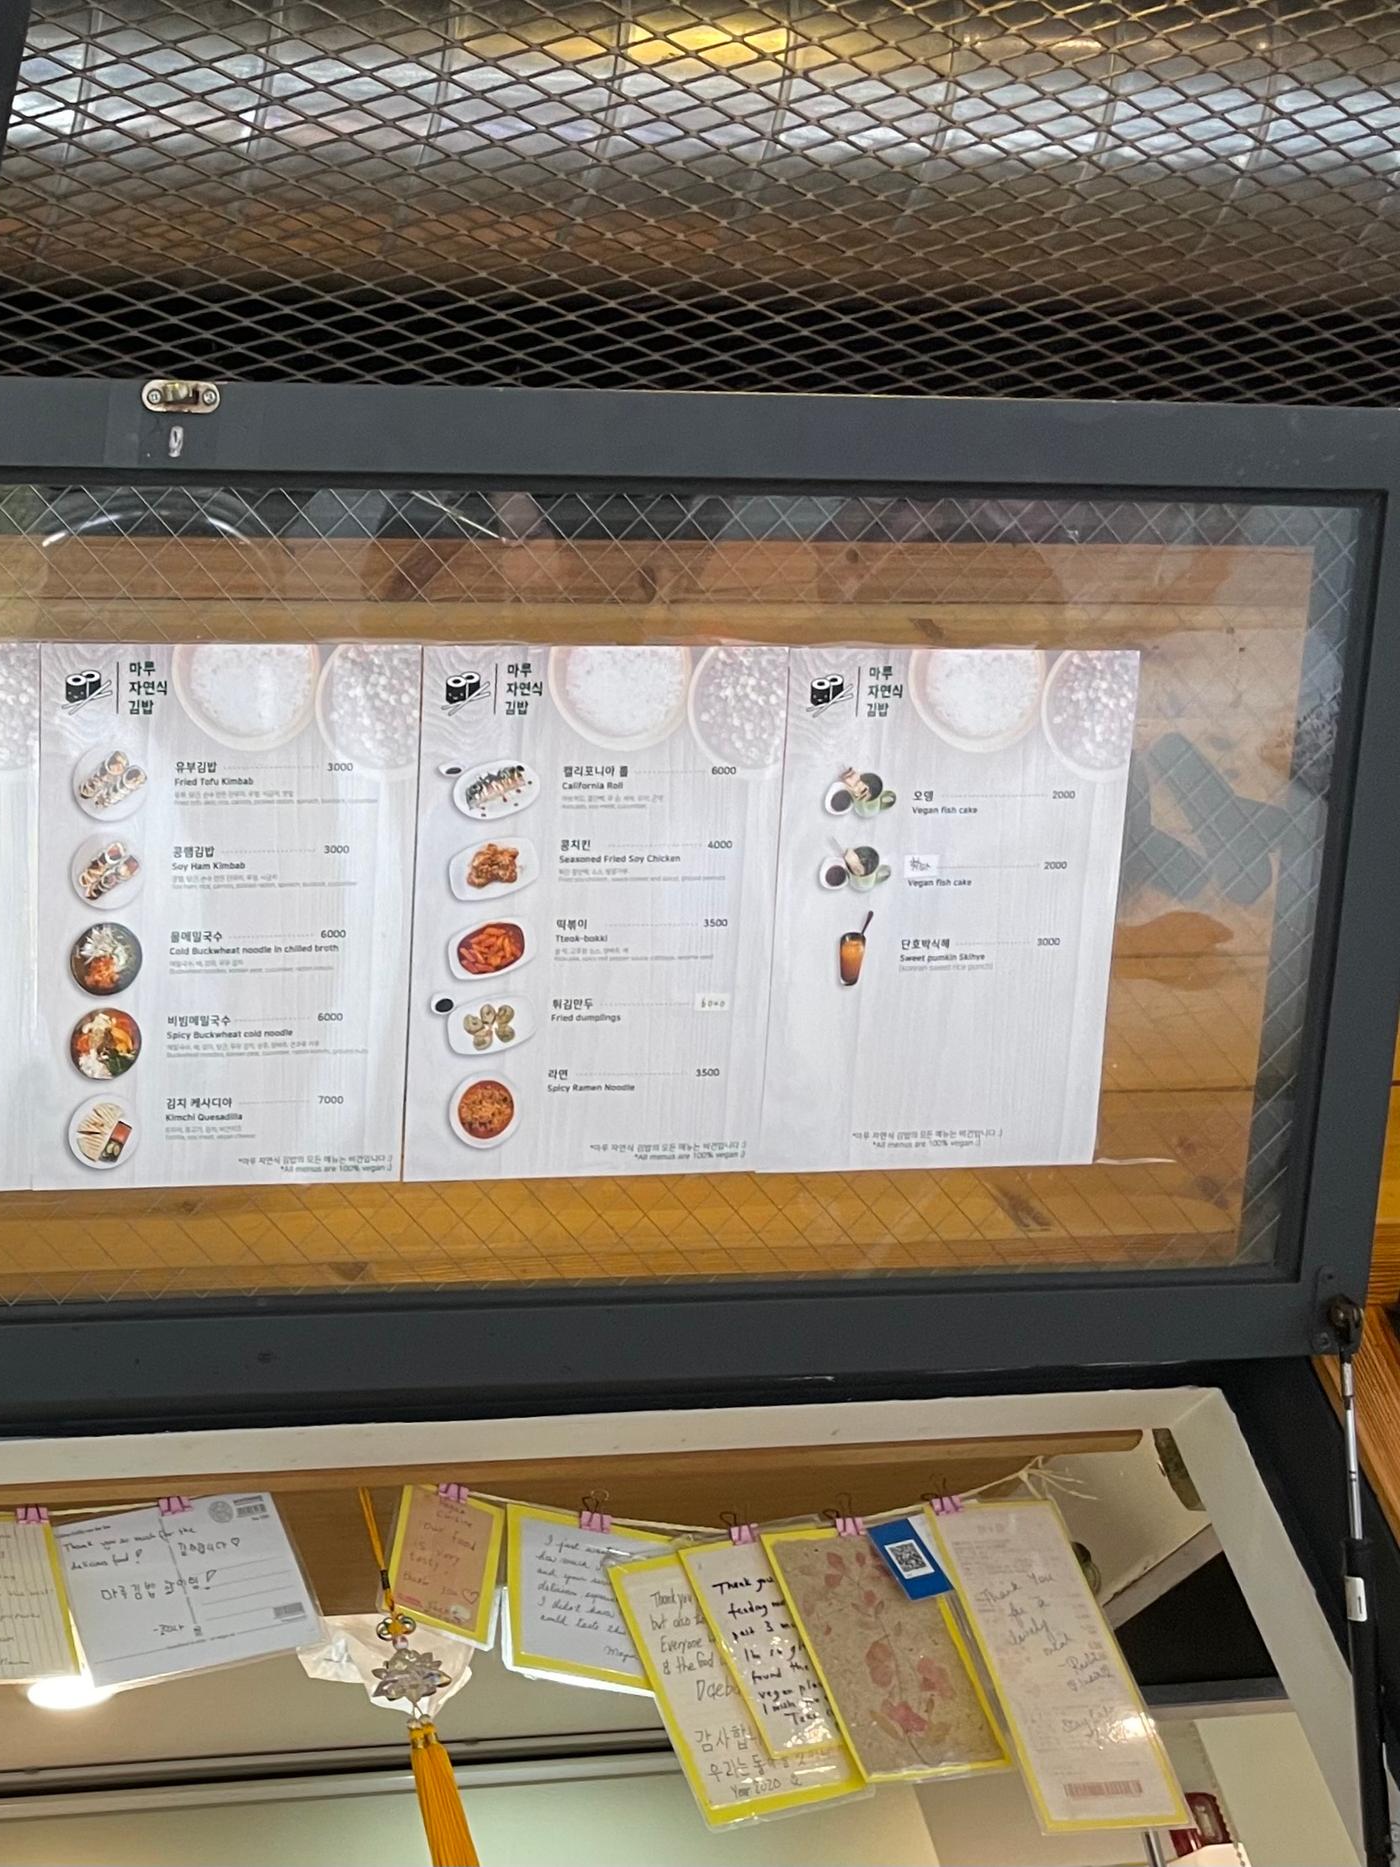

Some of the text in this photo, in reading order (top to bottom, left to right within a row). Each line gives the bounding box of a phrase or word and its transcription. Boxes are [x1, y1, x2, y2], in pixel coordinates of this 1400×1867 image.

[129, 661, 156, 676] 마루
[507, 663, 532, 677] 마루
[869, 666, 893, 680] 마루
[129, 681, 167, 695] 자연식
[506, 681, 543, 696] 자연식
[868, 684, 903, 699] 자연식
[129, 700, 153, 715] 김밥
[505, 701, 528, 715] 김밥
[866, 703, 889, 717] 김밥
[176, 761, 353, 773] 유부김밥 3000
[563, 766, 737, 777] 캘리포니아 6000
[1052, 790, 1075, 799] 2000
[324, 845, 349, 854] 3000
[708, 840, 732, 849] 4000
[1044, 861, 1067, 870] 2000
[556, 919, 728, 930] 떡볶이 3500
[321, 929, 346, 938] 6000
[552, 998, 593, 1010] 튀김만두
[168, 1013, 343, 1027] 비빔메밀국수 6000
[548, 1068, 720, 1080] 라면 3500
[166, 1098, 186, 1110] 김치
[318, 1096, 344, 1104] 7000
